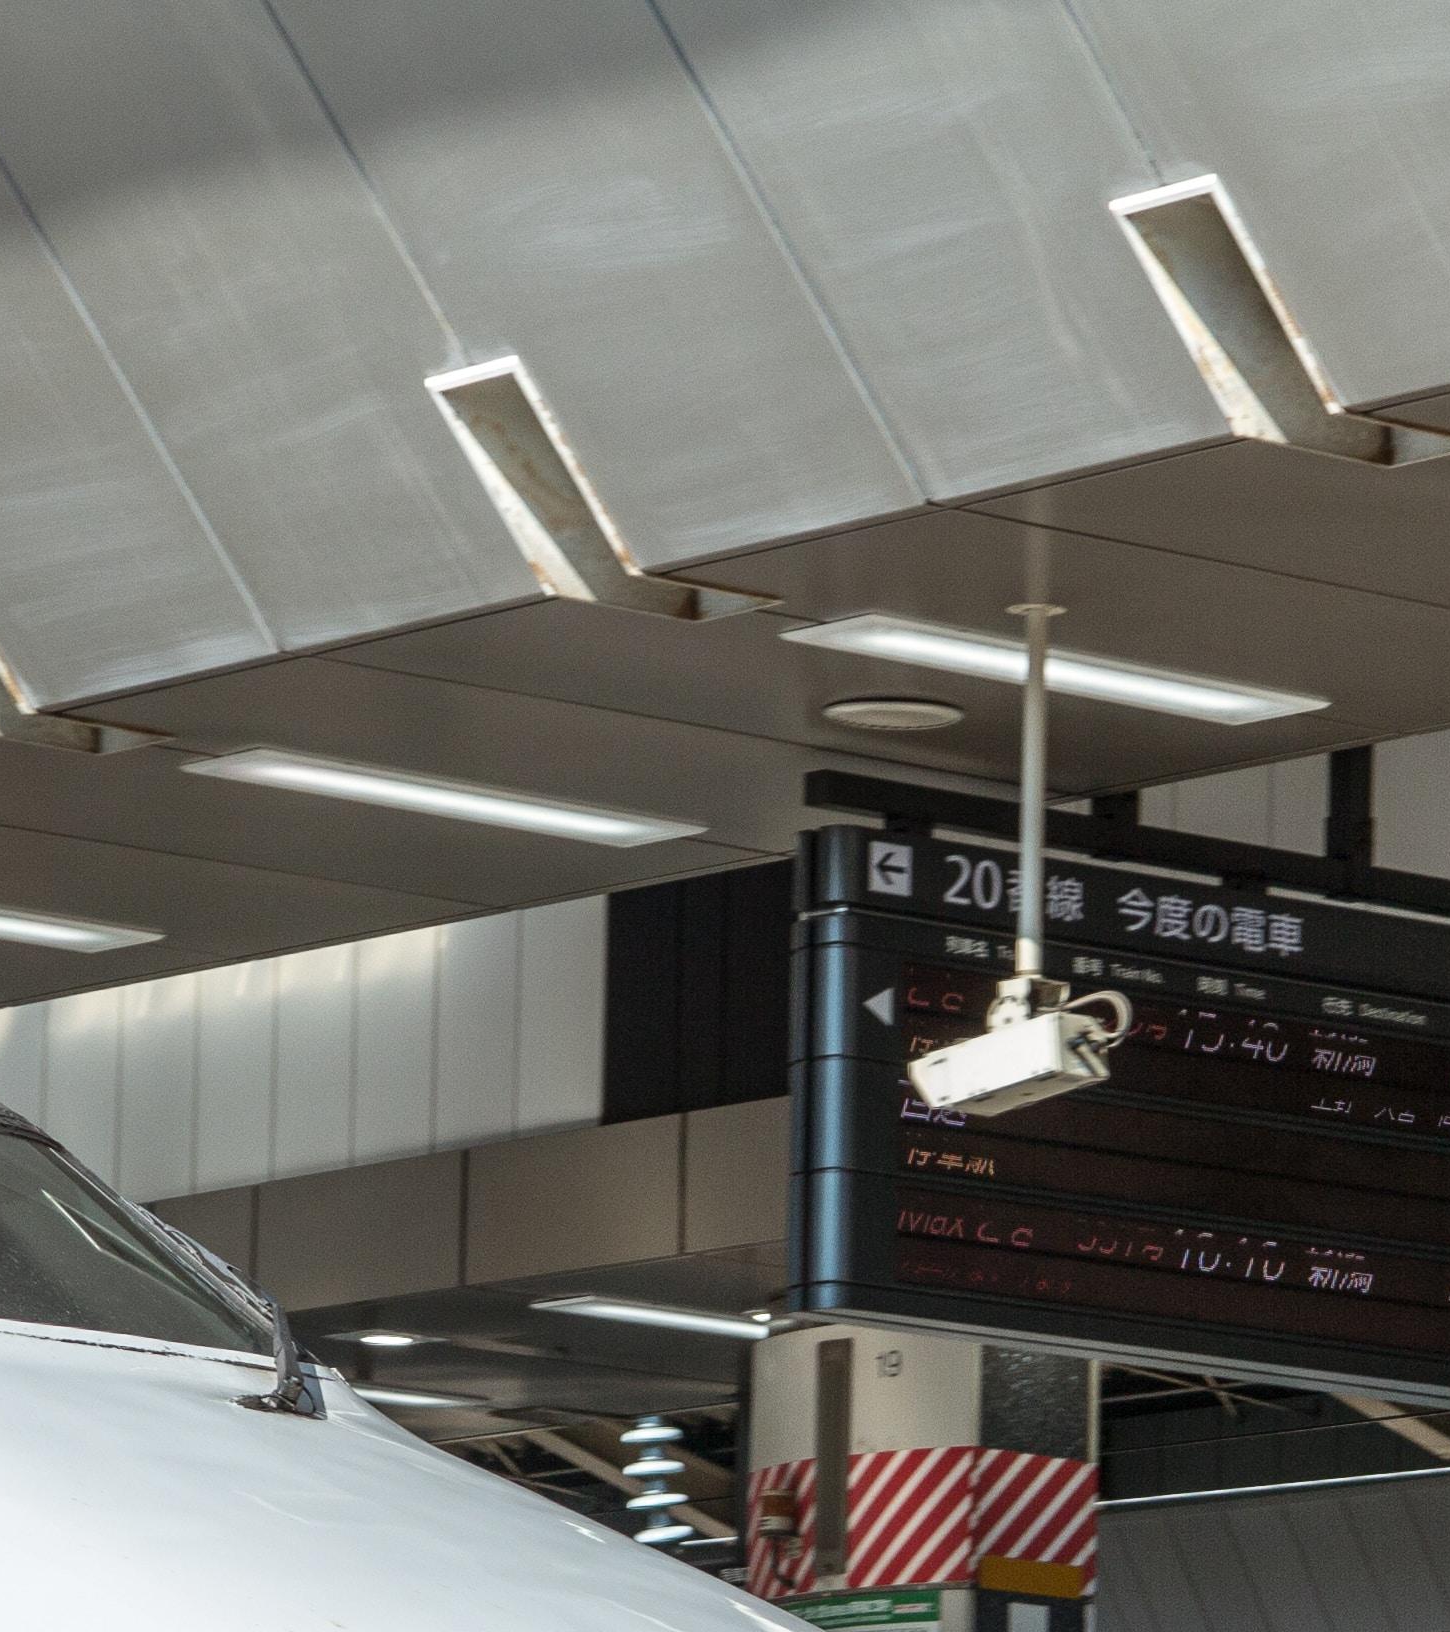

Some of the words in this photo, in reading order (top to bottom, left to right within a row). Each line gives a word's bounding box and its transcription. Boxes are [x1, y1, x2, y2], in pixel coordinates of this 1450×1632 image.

[1116, 887, 1305, 957] 今度の電車
